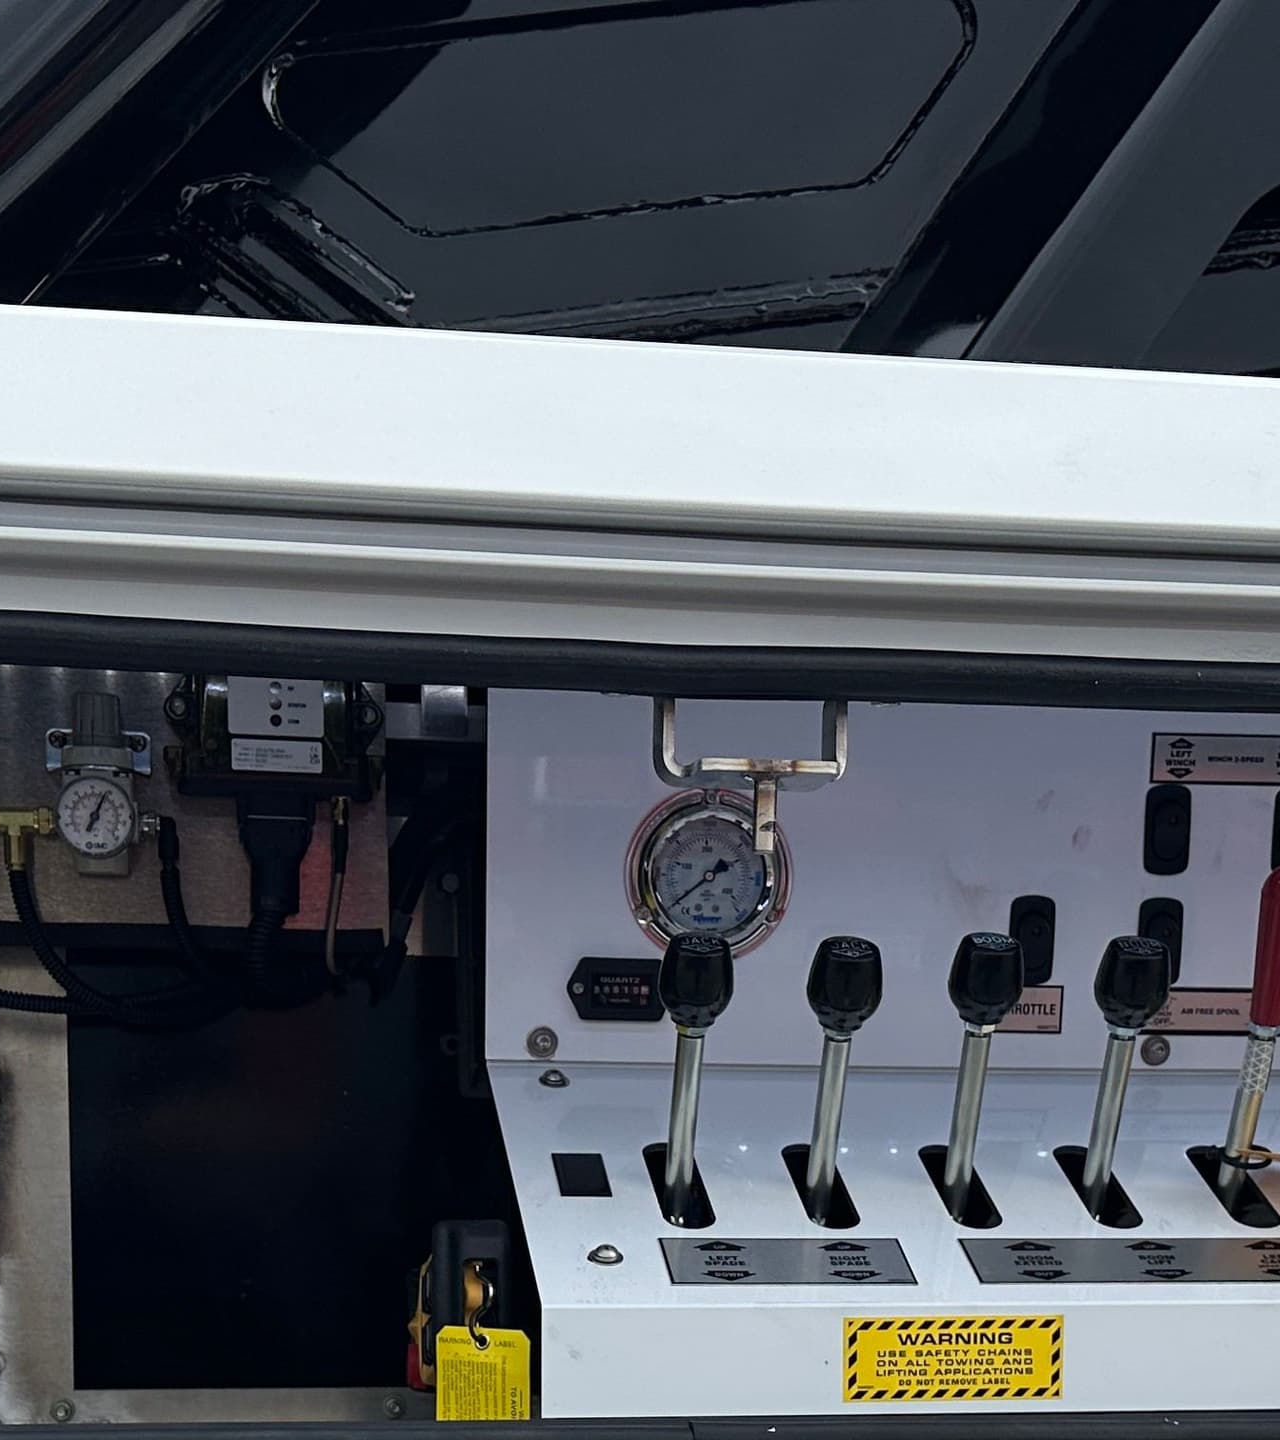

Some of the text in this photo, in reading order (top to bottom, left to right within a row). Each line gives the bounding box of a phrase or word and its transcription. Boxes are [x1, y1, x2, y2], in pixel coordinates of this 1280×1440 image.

[1171, 750, 1192, 758] LEFT
[1166, 759, 1196, 767] WINCH
[1216, 1008, 1240, 1016] SPOOL
[897, 1332, 1013, 1345] WARNING
[877, 1348, 1033, 1358] USE SAFETY CHAINS
[876, 1358, 1034, 1367] ON ALL TOWING AND
[876, 1367, 1034, 1376] LIFTING APPLICATIONS
[918, 1378, 936, 1386] NOT
[939, 1378, 976, 1386] REMOVE
[982, 1378, 1011, 1386] LABEL
